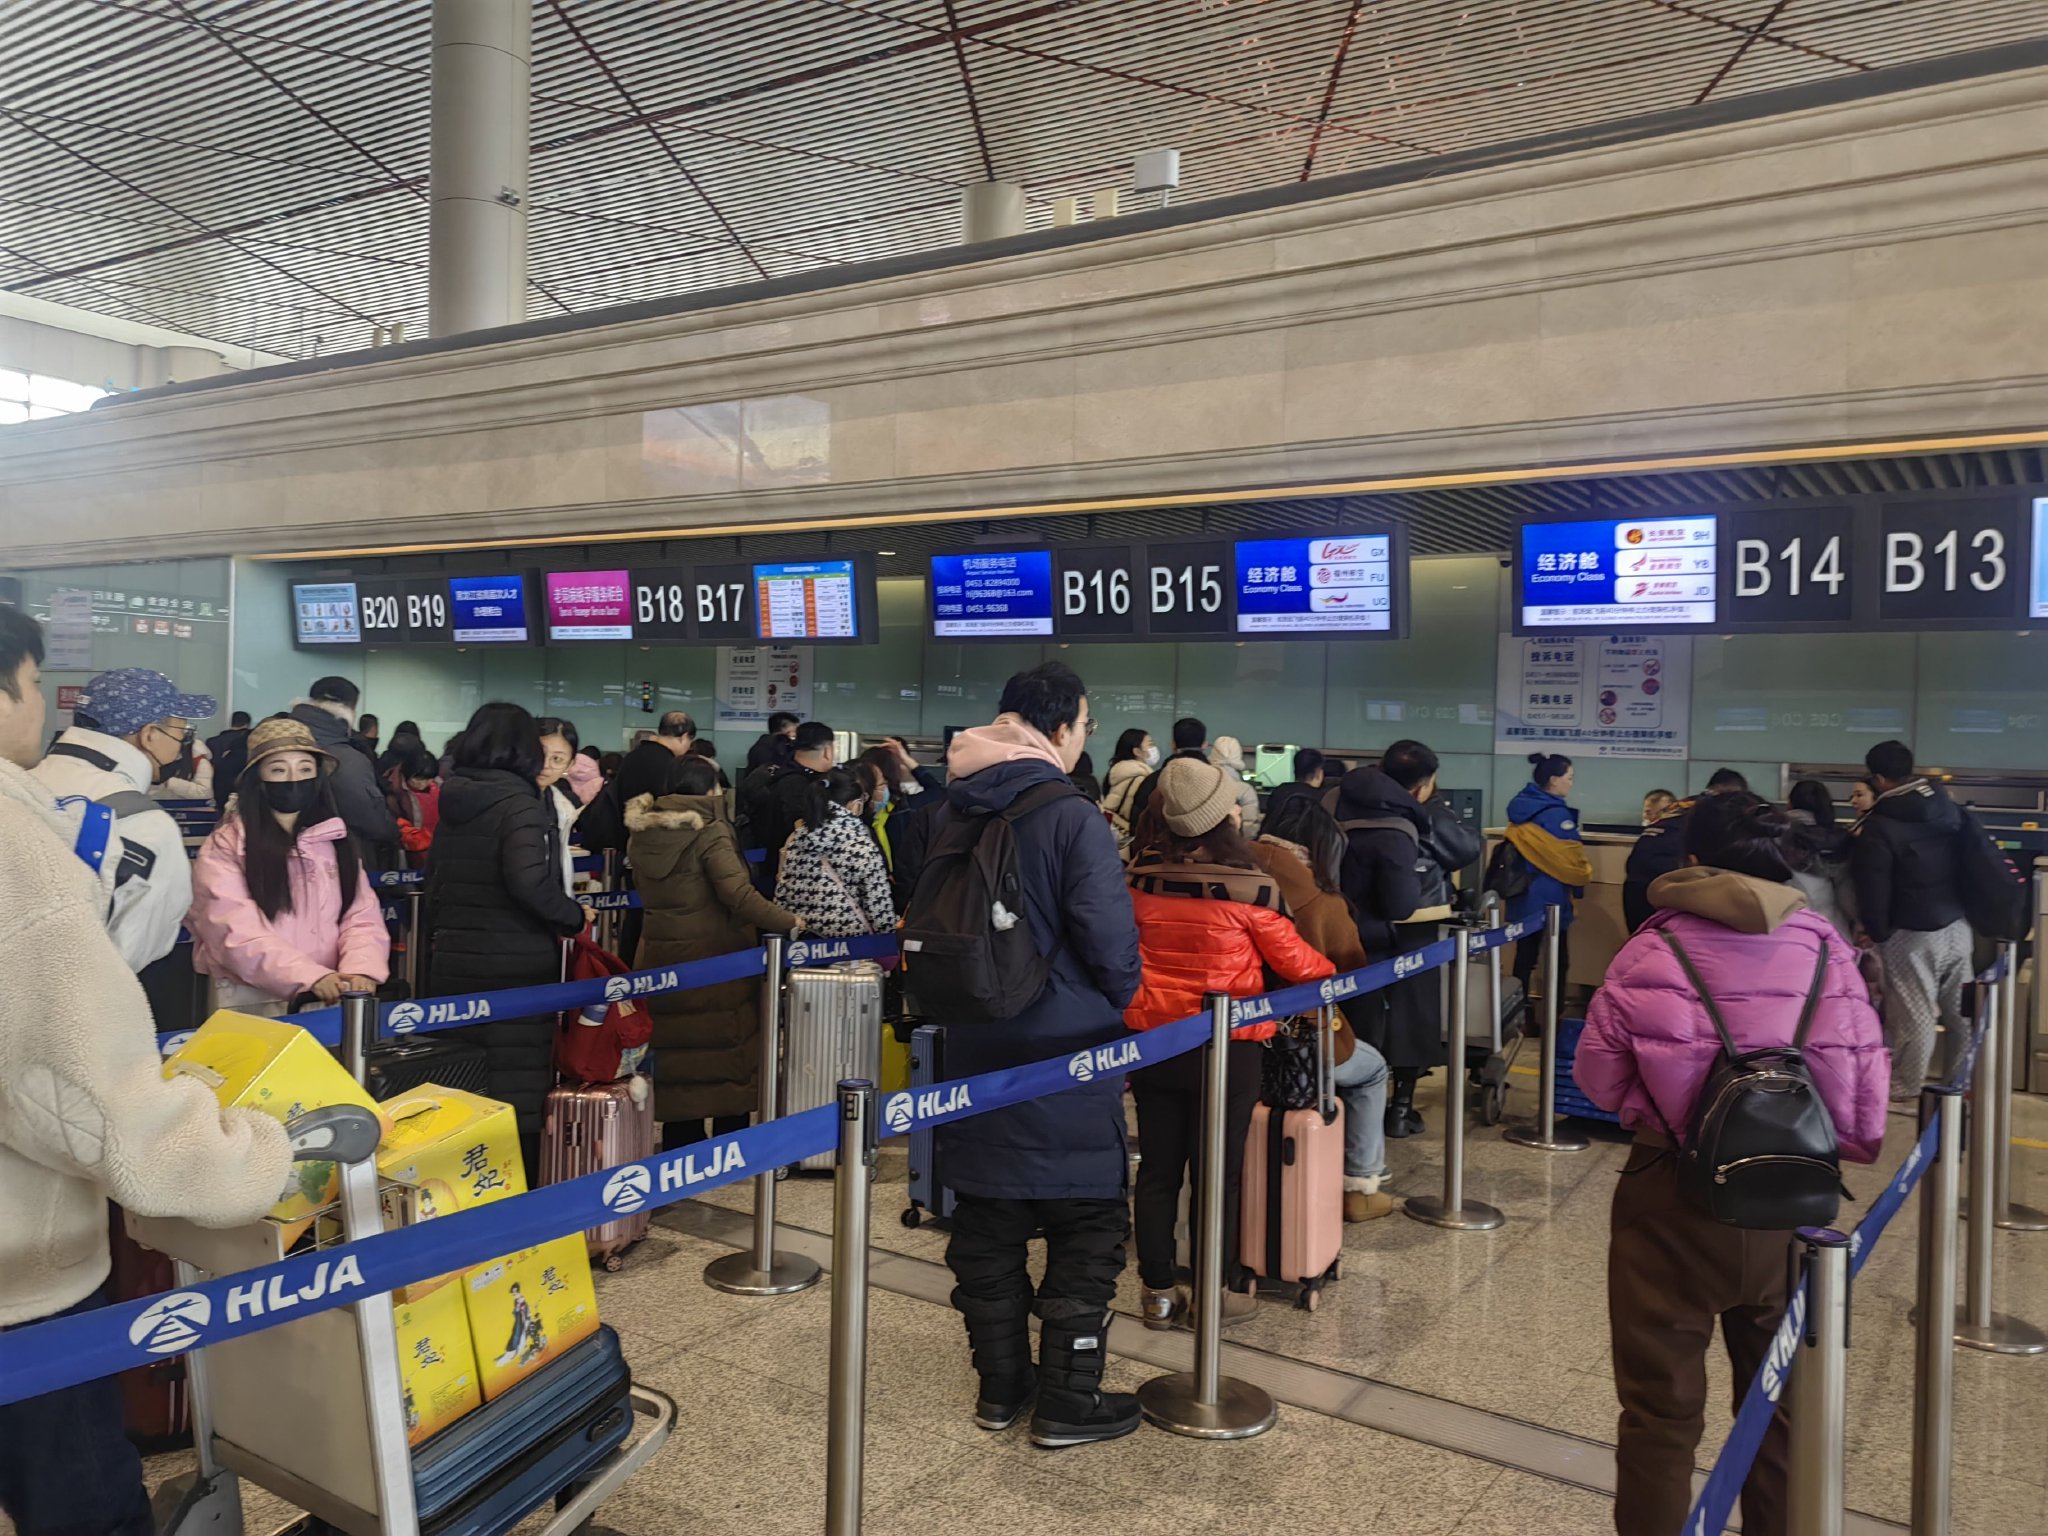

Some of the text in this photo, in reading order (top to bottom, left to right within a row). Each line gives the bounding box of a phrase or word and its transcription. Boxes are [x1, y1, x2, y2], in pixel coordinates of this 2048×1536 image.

[1693, 531, 1710, 540] 9H
[1537, 552, 1599, 571] 经济舱
[1736, 536, 1845, 597] B14
[1885, 528, 2006, 593] B13
[1248, 566, 1297, 584] 经济舱
[1370, 573, 1384, 582] FU
[1532, 572, 1605, 584] Economy Class
[1064, 568, 1130, 615] B16
[1150, 565, 1222, 613] B15
[1243, 584, 1302, 594] Economy Class
[1693, 586, 1710, 596] JD
[362, 596, 399, 629] B20
[407, 594, 445, 628] B19
[636, 585, 684, 623] B18
[696, 584, 744, 622] B17
[1530, 651, 1575, 662] 投诉电话
[596, 890, 630, 908] HLJA
[810, 940, 849, 960] HLJA
[632, 970, 679, 995] HLJA
[1334, 975, 1359, 996] HLJA
[428, 999, 492, 1024] HLJA
[1244, 998, 1274, 1020] HLJA
[1095, 1041, 1142, 1072] HLJA
[916, 1084, 972, 1121] HLJA
[658, 1141, 746, 1193] HLJA
[226, 1254, 366, 1323] HLJA
